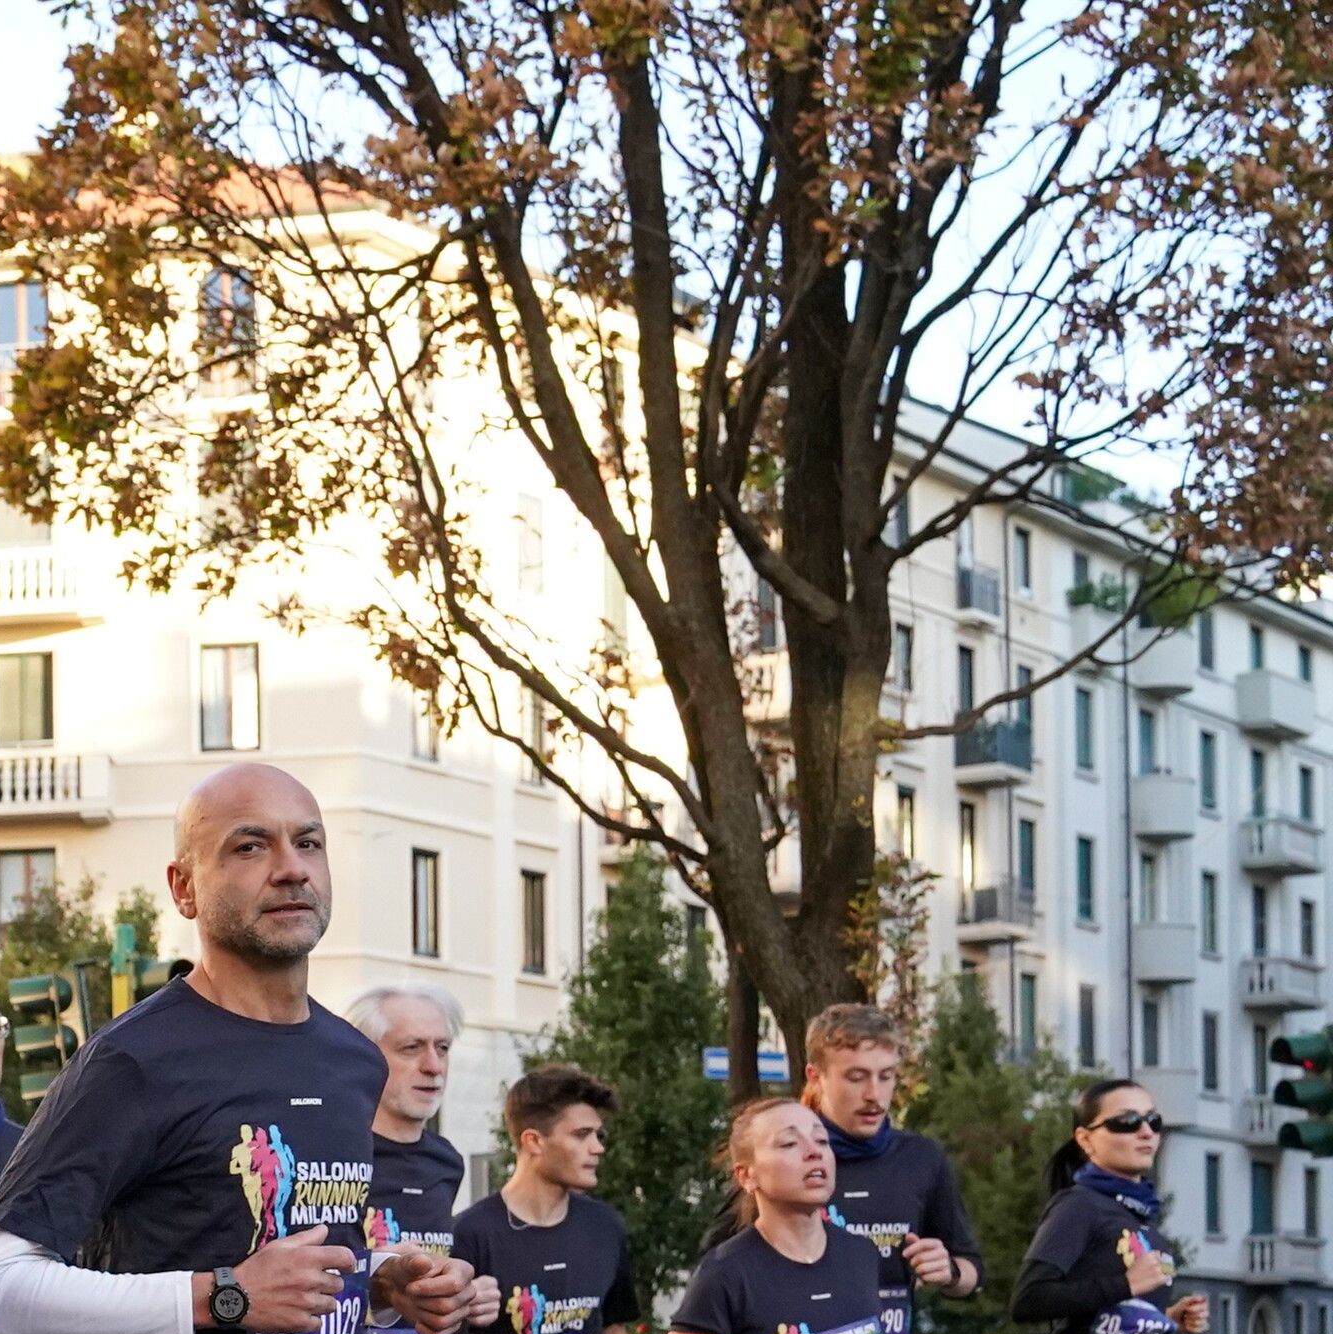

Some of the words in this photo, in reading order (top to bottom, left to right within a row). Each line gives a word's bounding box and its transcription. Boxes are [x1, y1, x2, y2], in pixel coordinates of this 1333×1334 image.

[296, 1161, 373, 1183] SALOMON
[294, 1181, 371, 1209] RUNNING
[290, 1204, 359, 1227] MILANO
